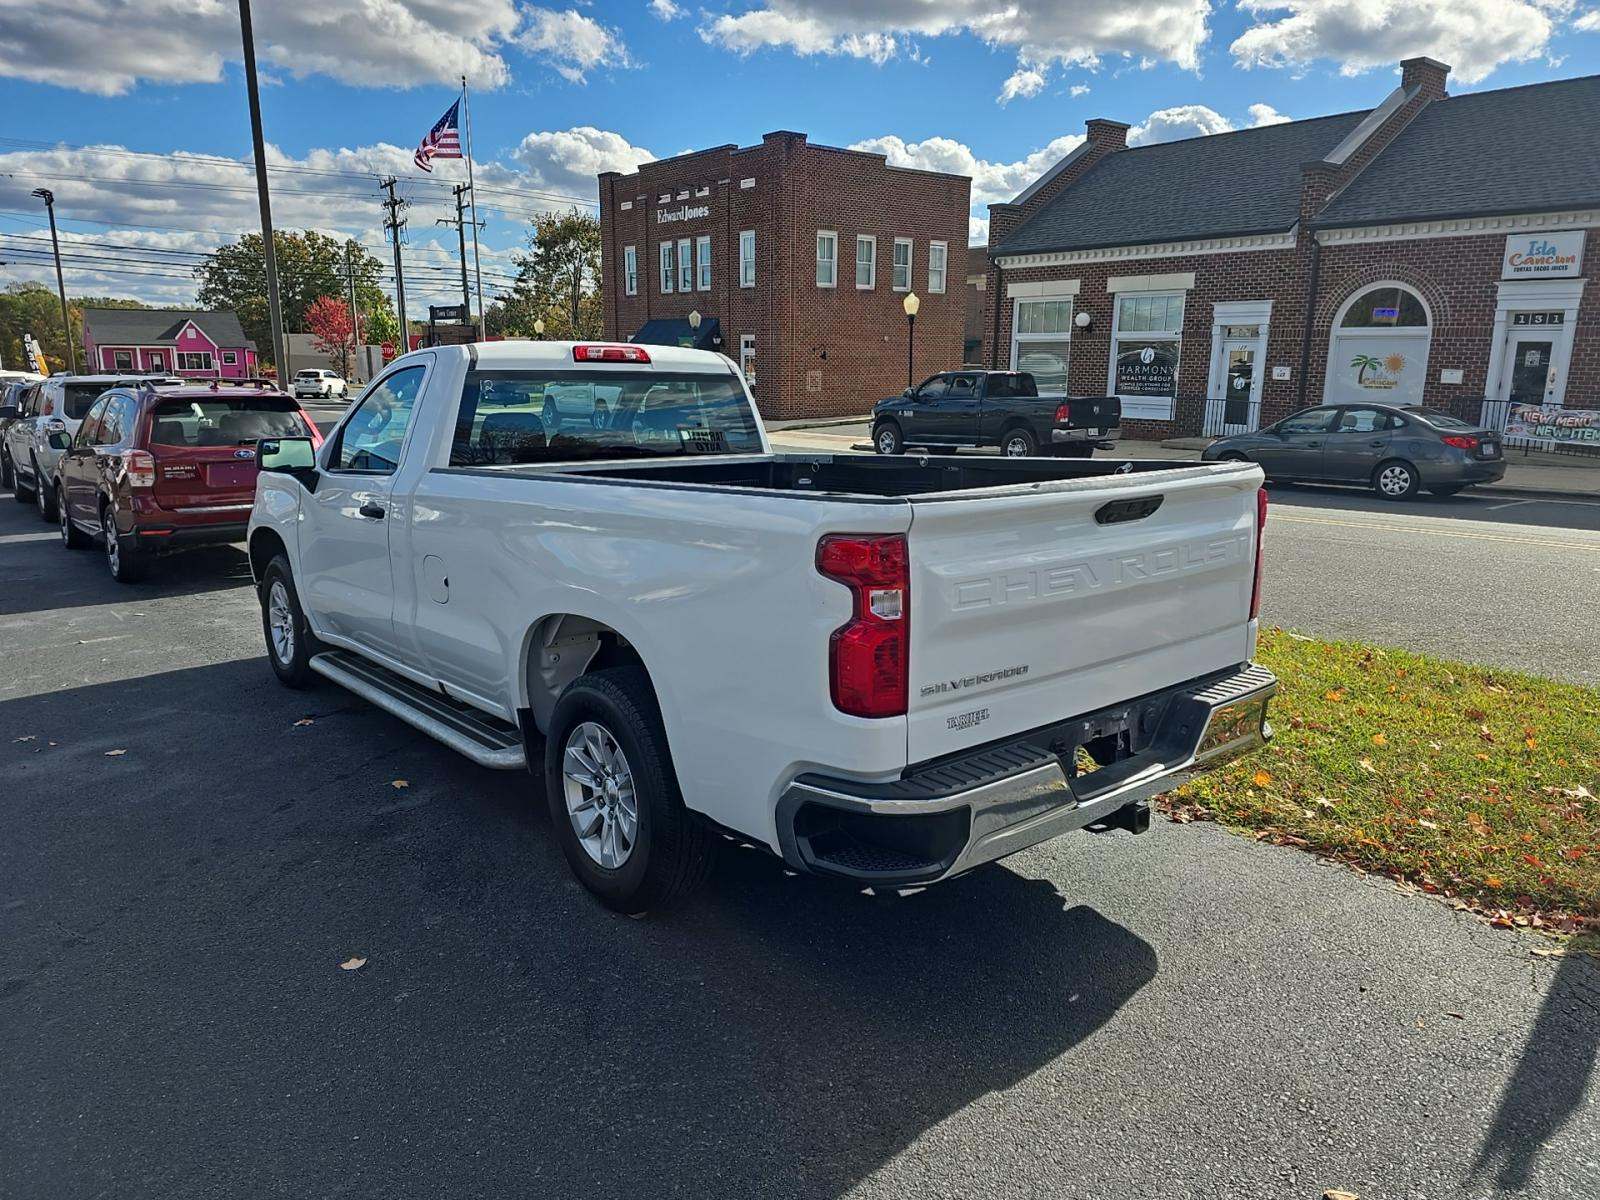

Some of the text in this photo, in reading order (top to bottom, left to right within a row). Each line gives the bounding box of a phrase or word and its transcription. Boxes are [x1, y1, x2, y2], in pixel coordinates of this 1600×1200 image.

[1526, 240, 1557, 256] Isla
[1508, 253, 1576, 267] Cancun
[1518, 313, 1560, 324] 131
[1117, 365, 1176, 375] HARMONY
[1522, 411, 1592, 427] NEW MENU
[1536, 424, 1564, 437] NEW
[952, 536, 1248, 612] CHEVROLET
[920, 665, 1029, 697] SILVERADO
